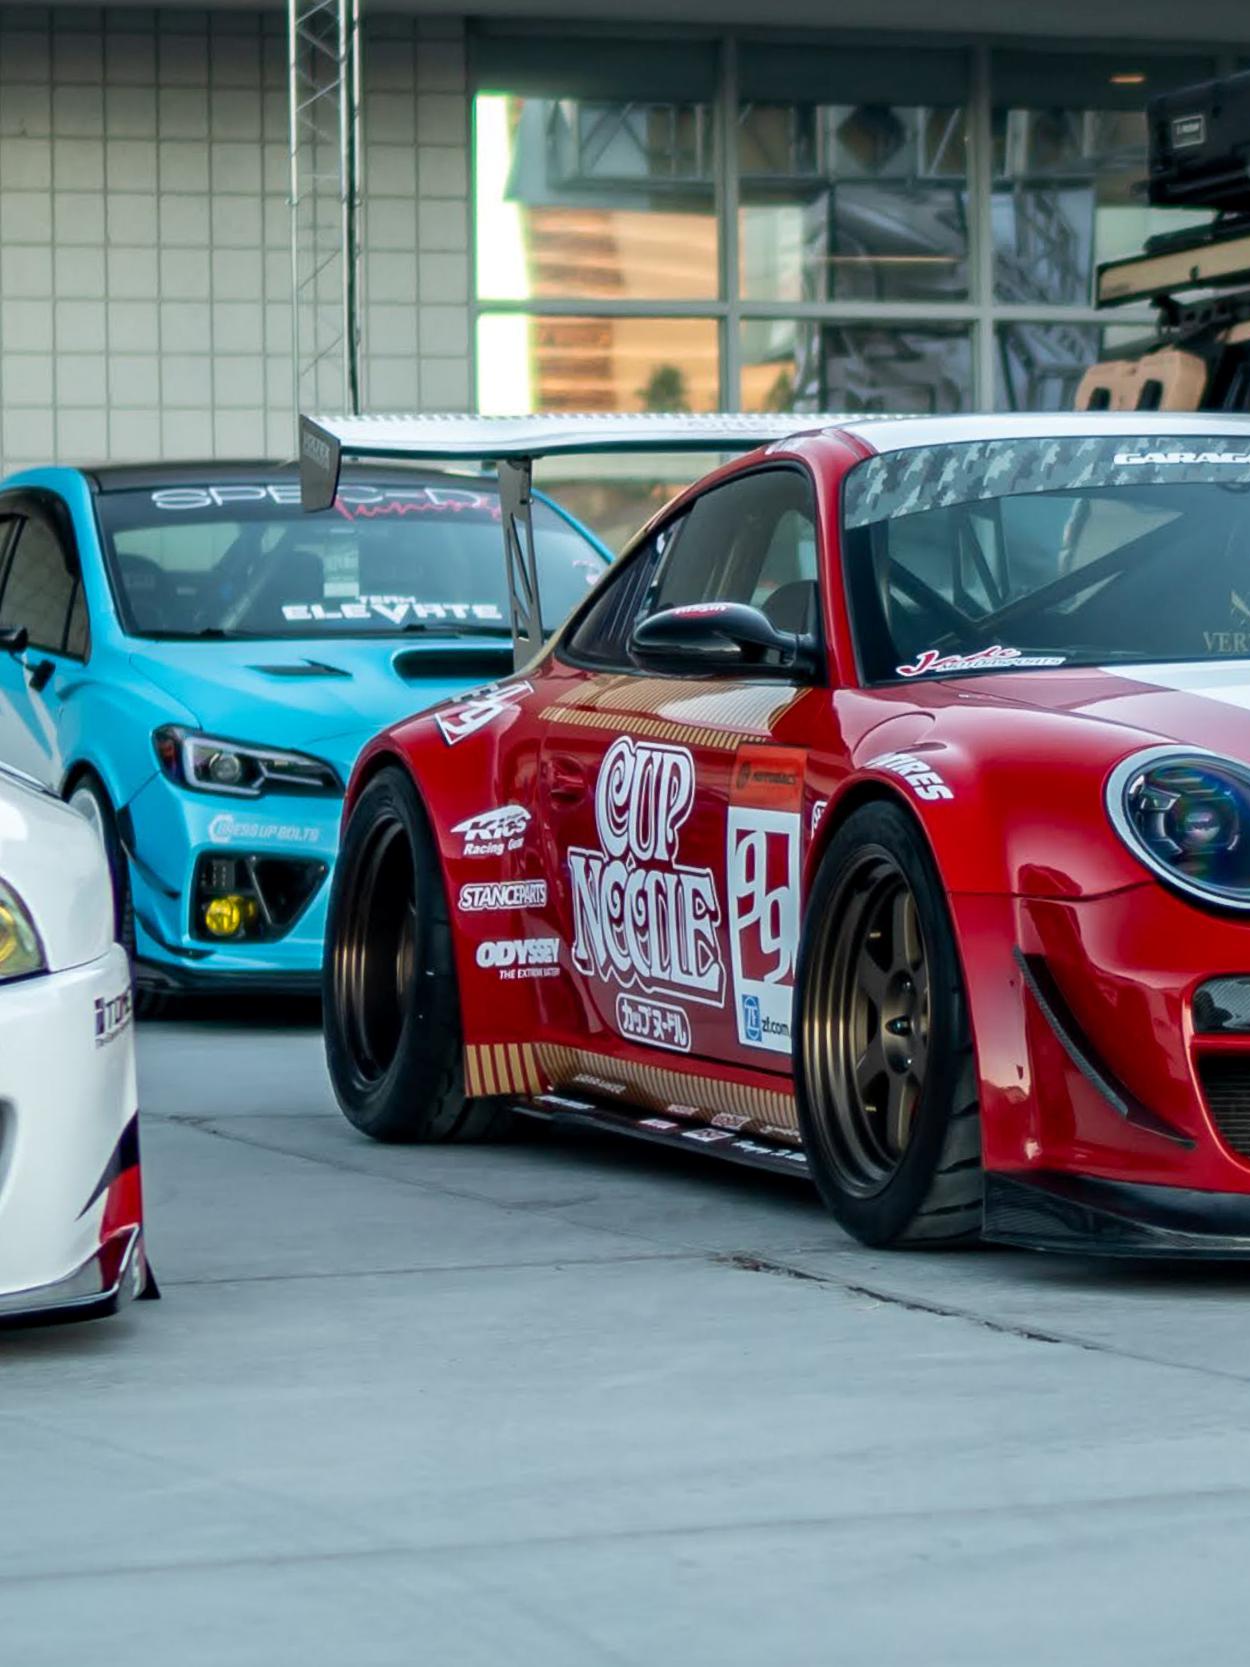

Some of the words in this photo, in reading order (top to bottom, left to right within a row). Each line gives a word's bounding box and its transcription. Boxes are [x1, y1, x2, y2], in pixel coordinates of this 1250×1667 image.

[282, 604, 503, 624] ELEVATE
[597, 738, 695, 862] CUP
[463, 842, 505, 856] Racing
[461, 882, 546, 910] STANCEPARTS
[476, 939, 560, 967] ODYSSEY
